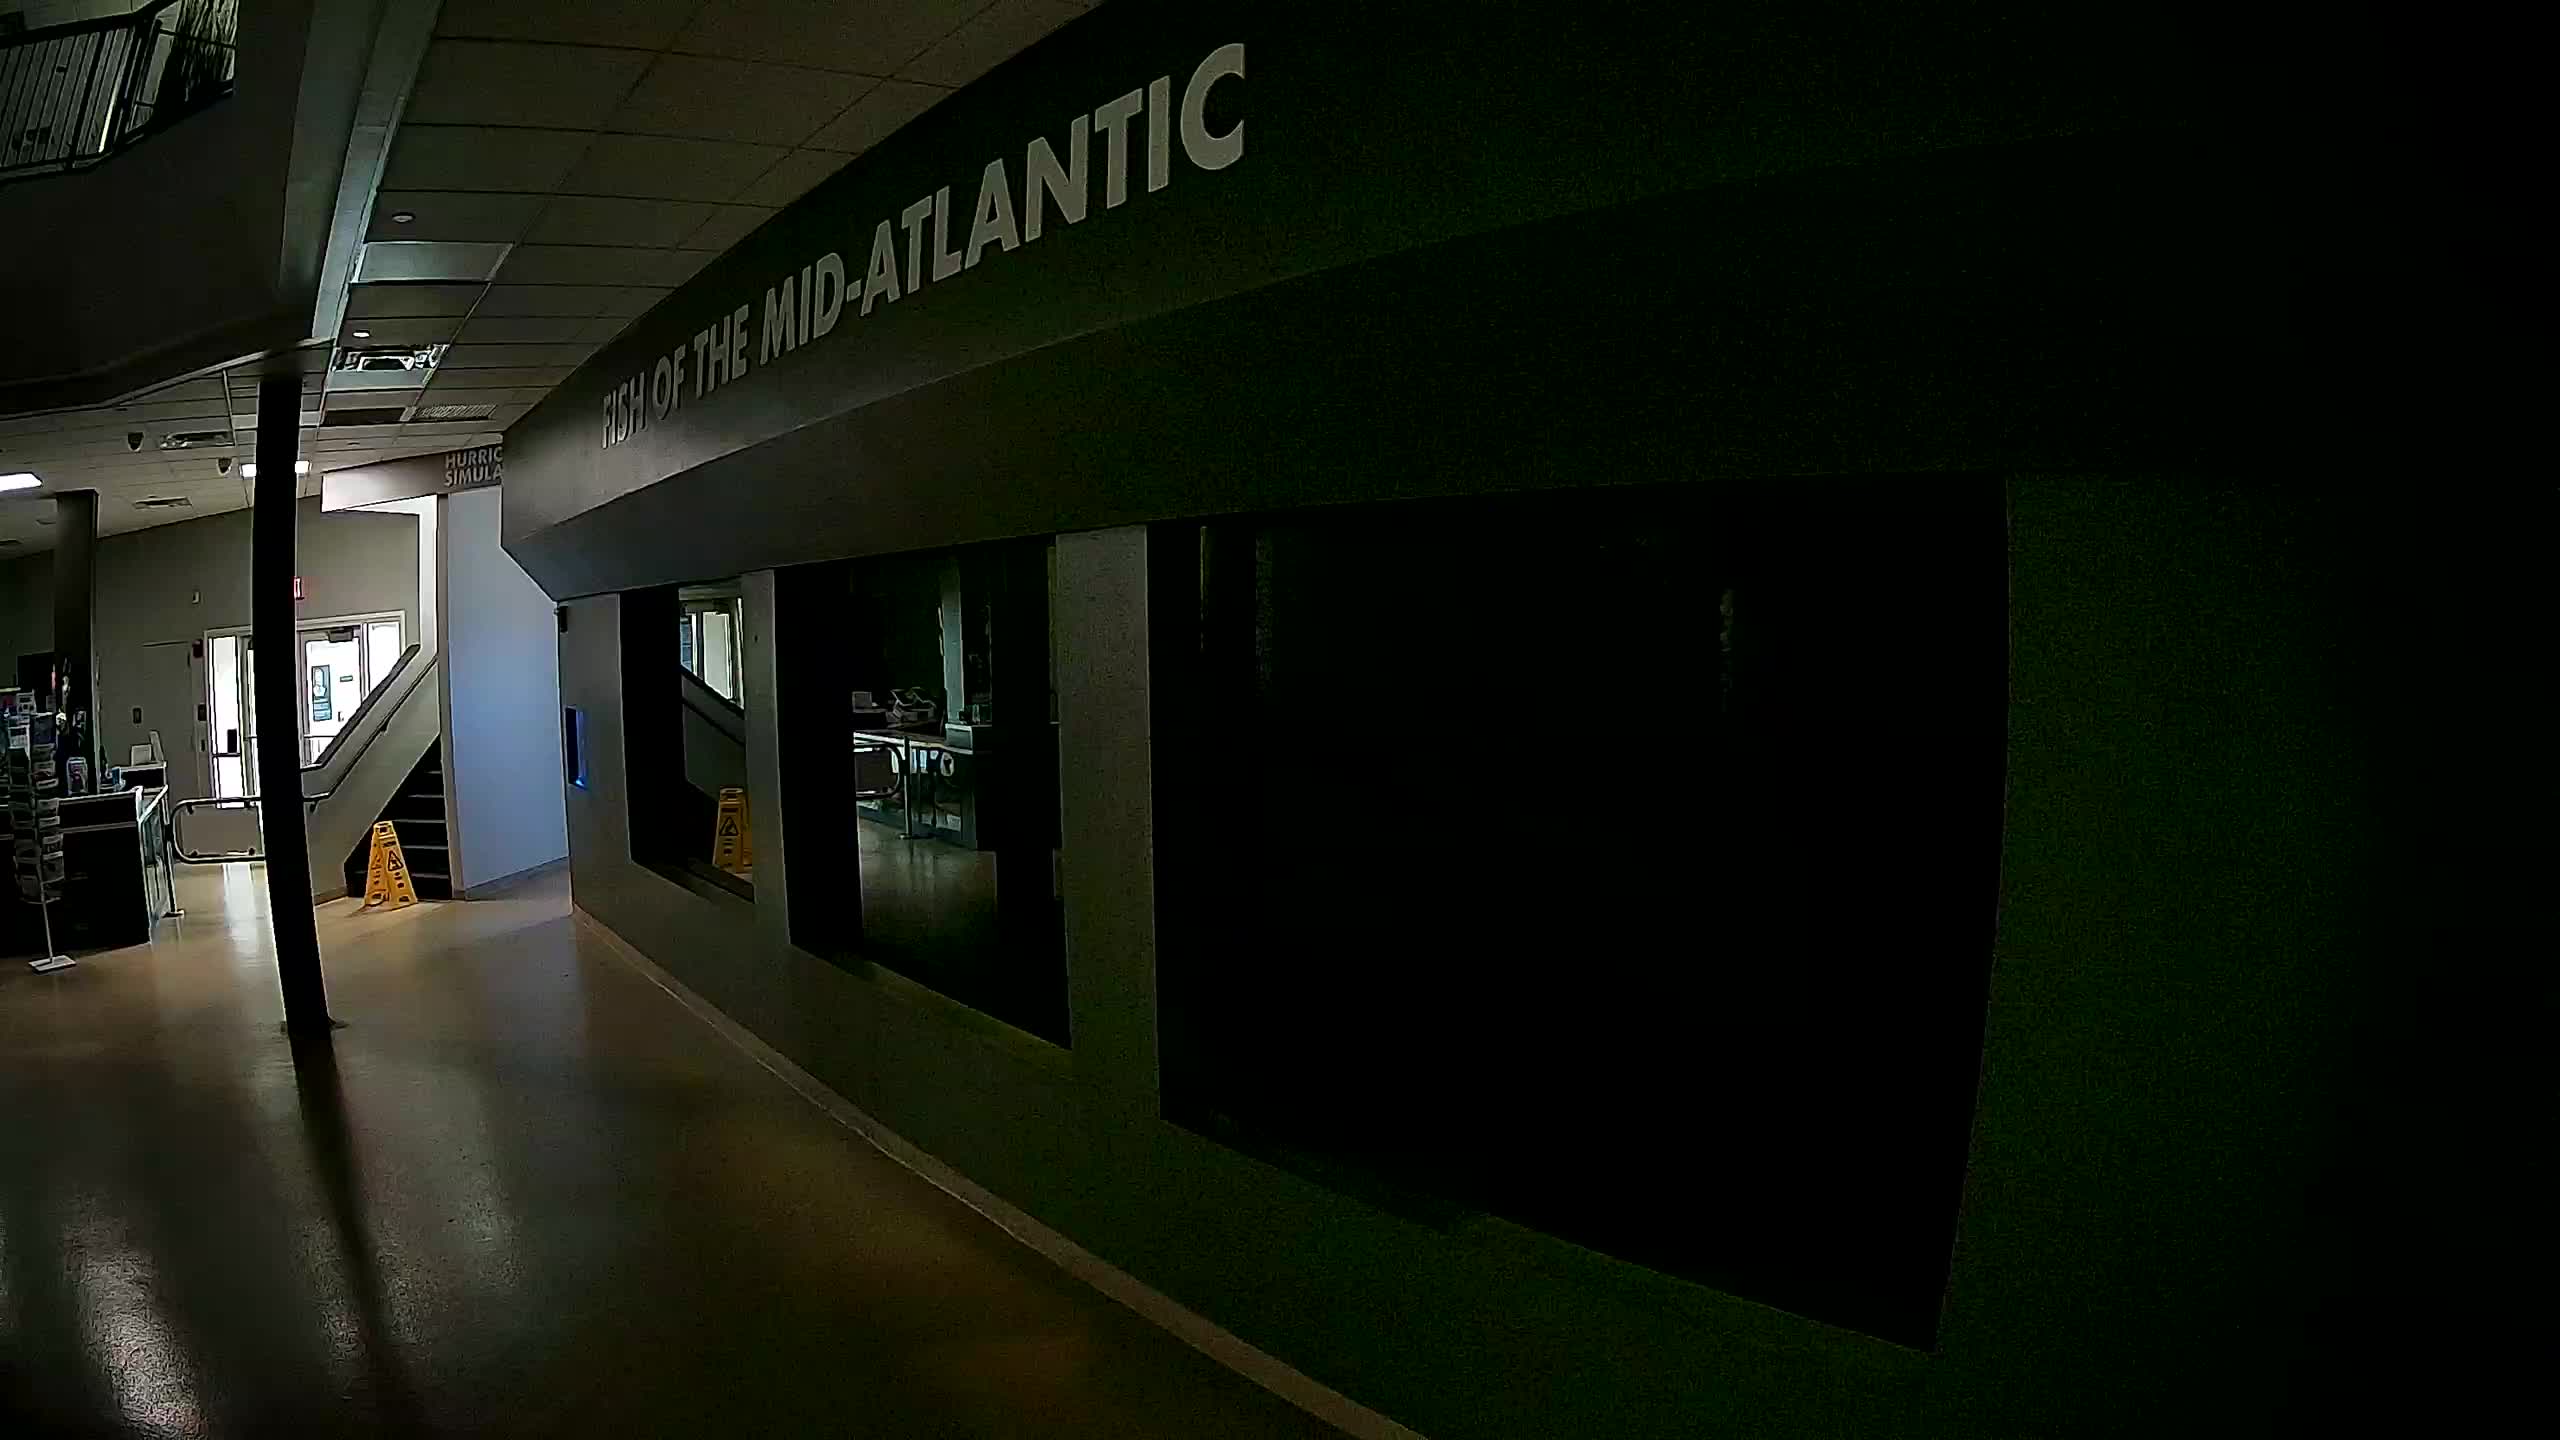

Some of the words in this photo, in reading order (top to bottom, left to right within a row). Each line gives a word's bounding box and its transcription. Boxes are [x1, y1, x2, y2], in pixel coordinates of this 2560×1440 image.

[602, 370, 648, 449] FISH
[652, 344, 687, 420] OF
[694, 303, 750, 399] THE
[760, 43, 1246, 367] MID-ATLANTIC
[445, 446, 503, 469] HURRIC
